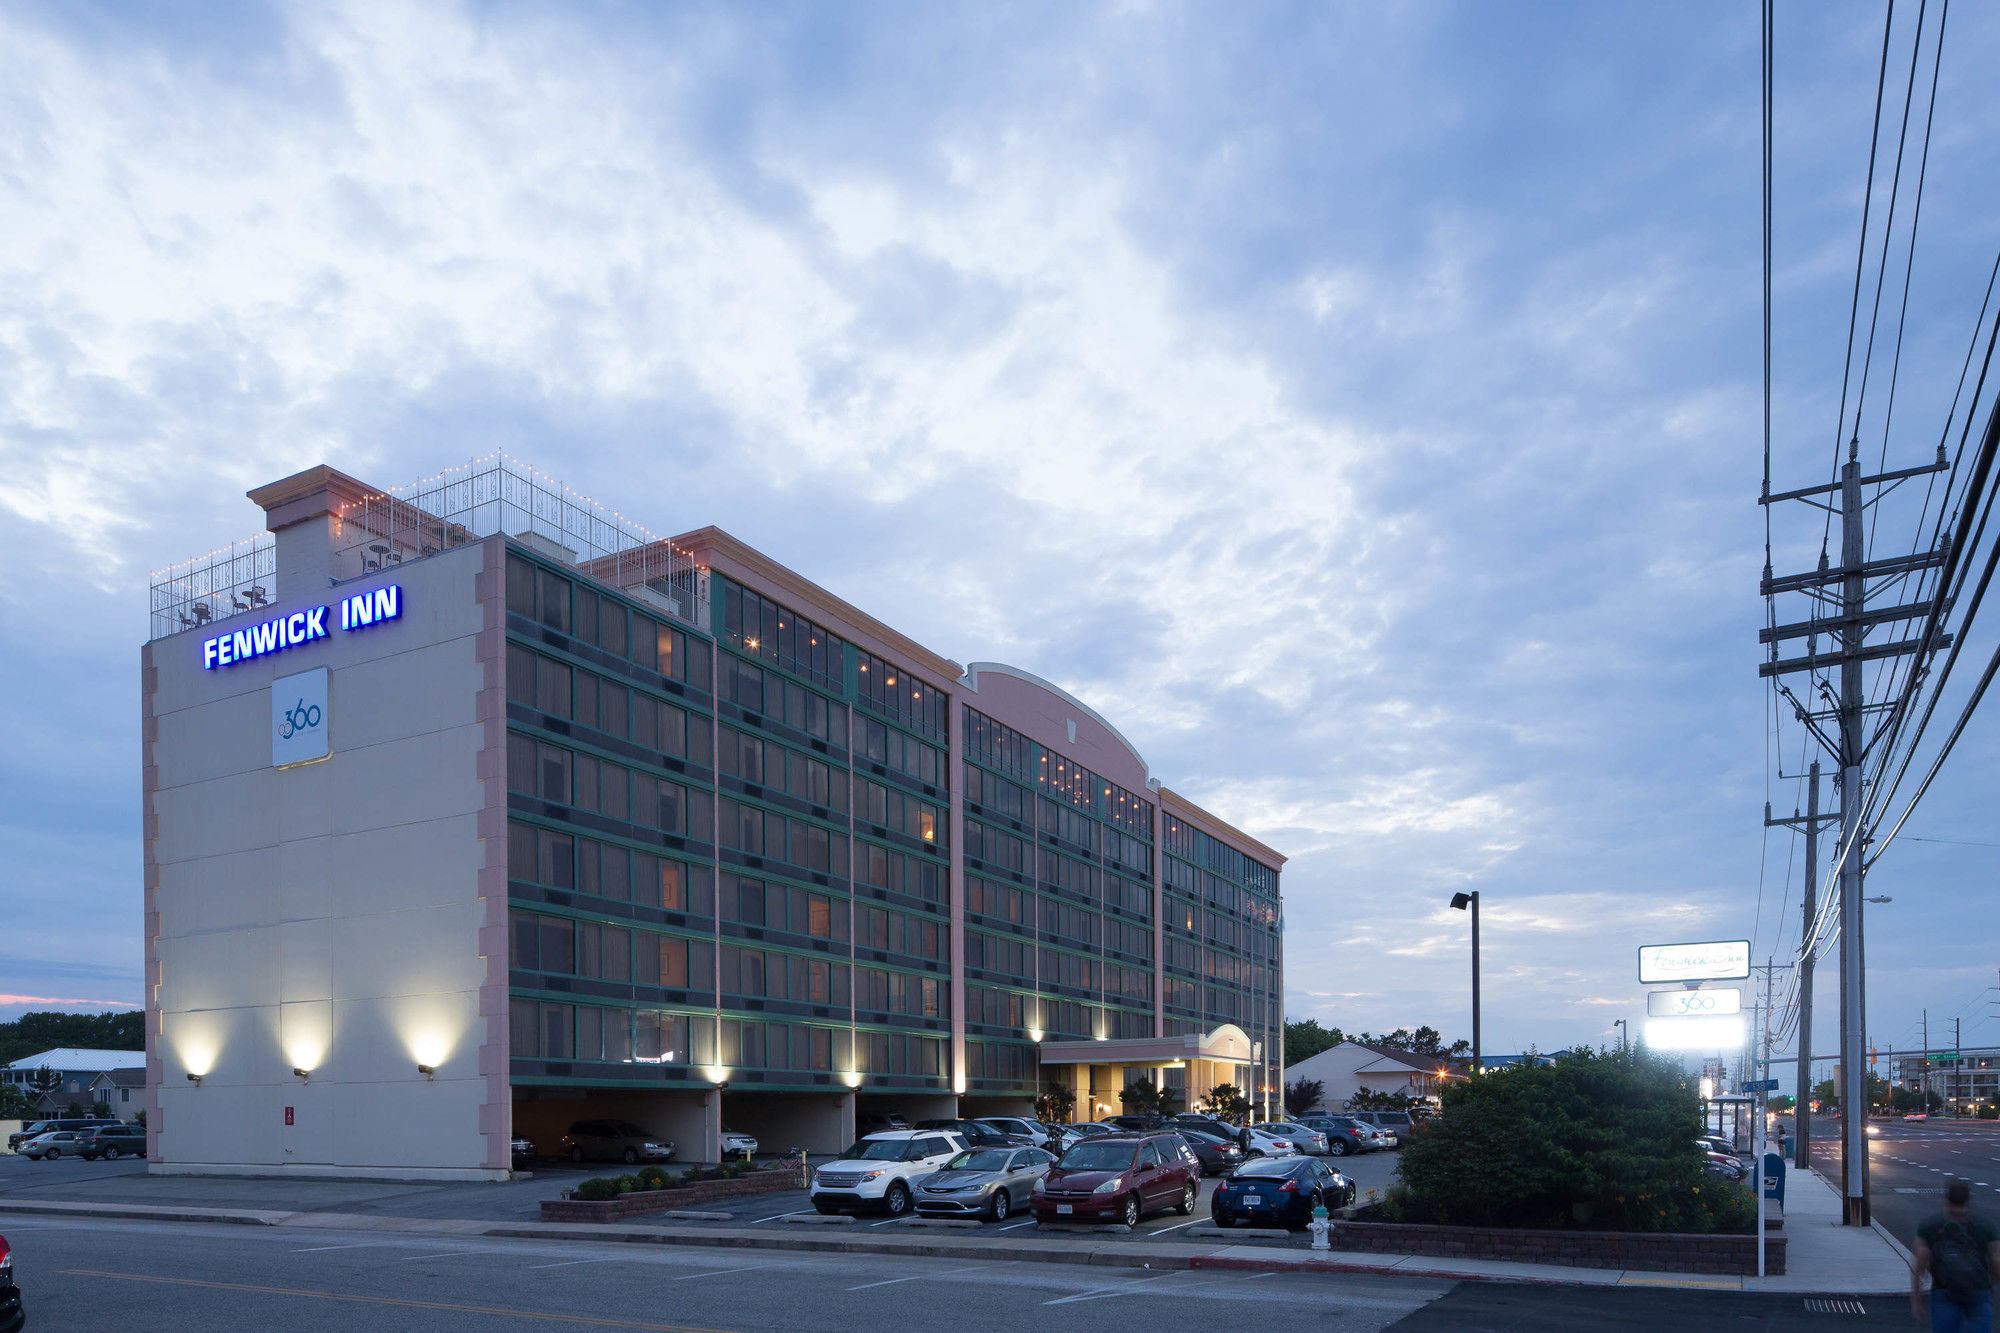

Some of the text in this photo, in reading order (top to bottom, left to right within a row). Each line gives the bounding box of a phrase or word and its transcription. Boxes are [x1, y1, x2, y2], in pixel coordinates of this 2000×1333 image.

[204, 585, 401, 669] FENWICK INN
[283, 698, 321, 739] 360
[1677, 992, 1715, 1014] 360
